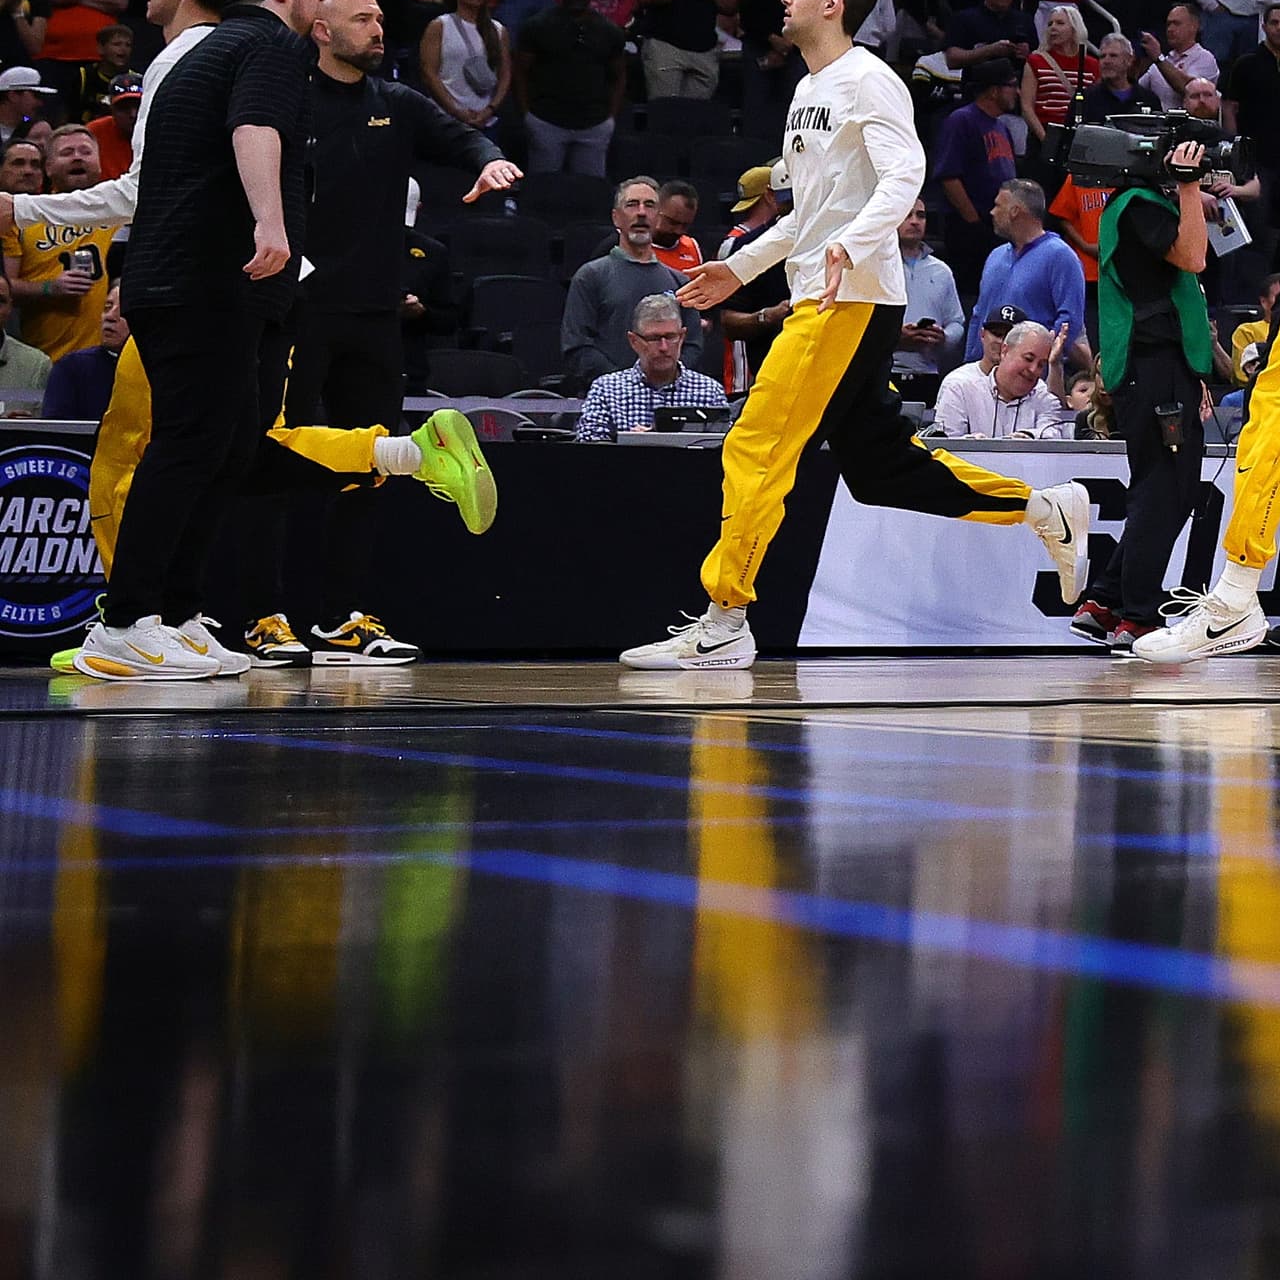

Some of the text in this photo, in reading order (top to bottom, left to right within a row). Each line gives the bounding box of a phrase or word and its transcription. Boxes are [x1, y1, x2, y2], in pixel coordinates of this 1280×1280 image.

[5, 460, 78, 479] SWEET 16
[2, 605, 61, 621] ELITE 8
